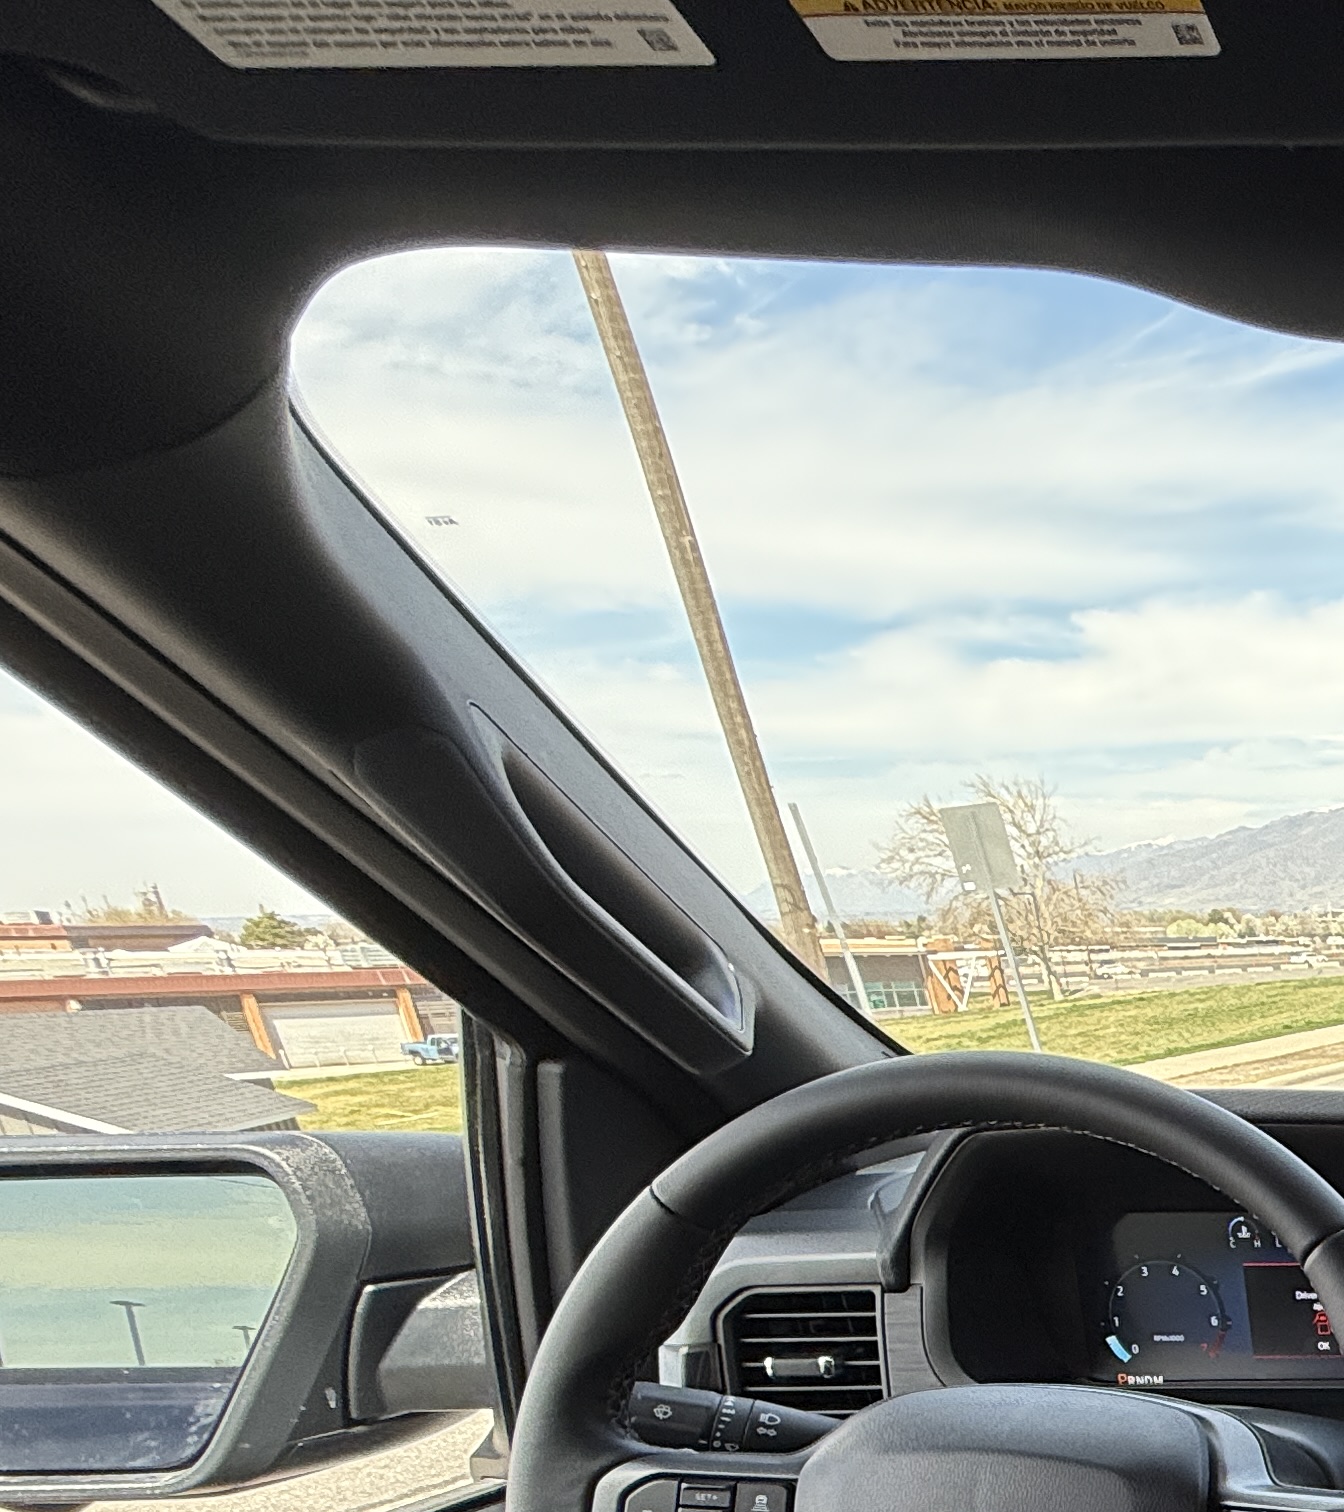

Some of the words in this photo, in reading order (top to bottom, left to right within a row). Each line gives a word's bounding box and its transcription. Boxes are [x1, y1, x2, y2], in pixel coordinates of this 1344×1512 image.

[1141, 1266, 1149, 1277] 3
[1171, 1265, 1180, 1276] 4
[1116, 1285, 1124, 1296] 2
[1200, 1284, 1208, 1295] 5
[1113, 1316, 1119, 1327] 1
[1210, 1315, 1219, 1327] 6
[1131, 1343, 1140, 1354] 0
[1318, 1341, 1331, 1351] OK
